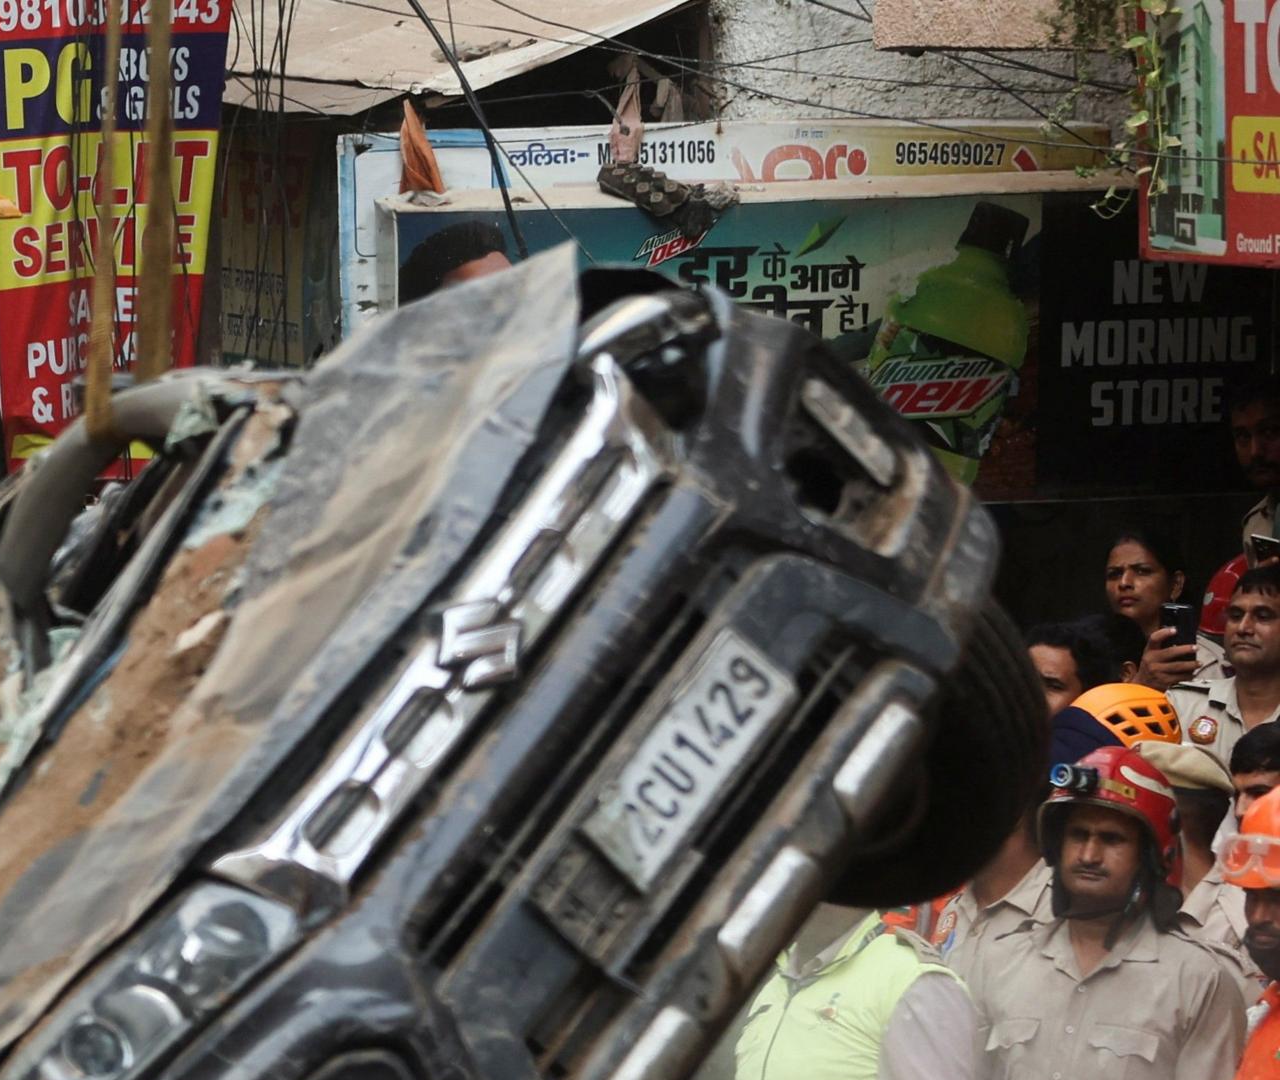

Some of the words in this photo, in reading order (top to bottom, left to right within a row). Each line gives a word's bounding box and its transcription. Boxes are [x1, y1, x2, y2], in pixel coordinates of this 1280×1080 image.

[2, 42, 93, 131] PG
[895, 141, 1007, 167] 9654699027
[1236, 232, 1273, 254] Ground
[758, 242, 791, 281] के
[790, 255, 868, 292] आगे
[1112, 258, 1208, 305] NEW
[68, 286, 139, 327] SAE
[1060, 315, 1257, 368] MORNING
[31, 386, 54, 424] &
[1090, 377, 1224, 427] STORE
